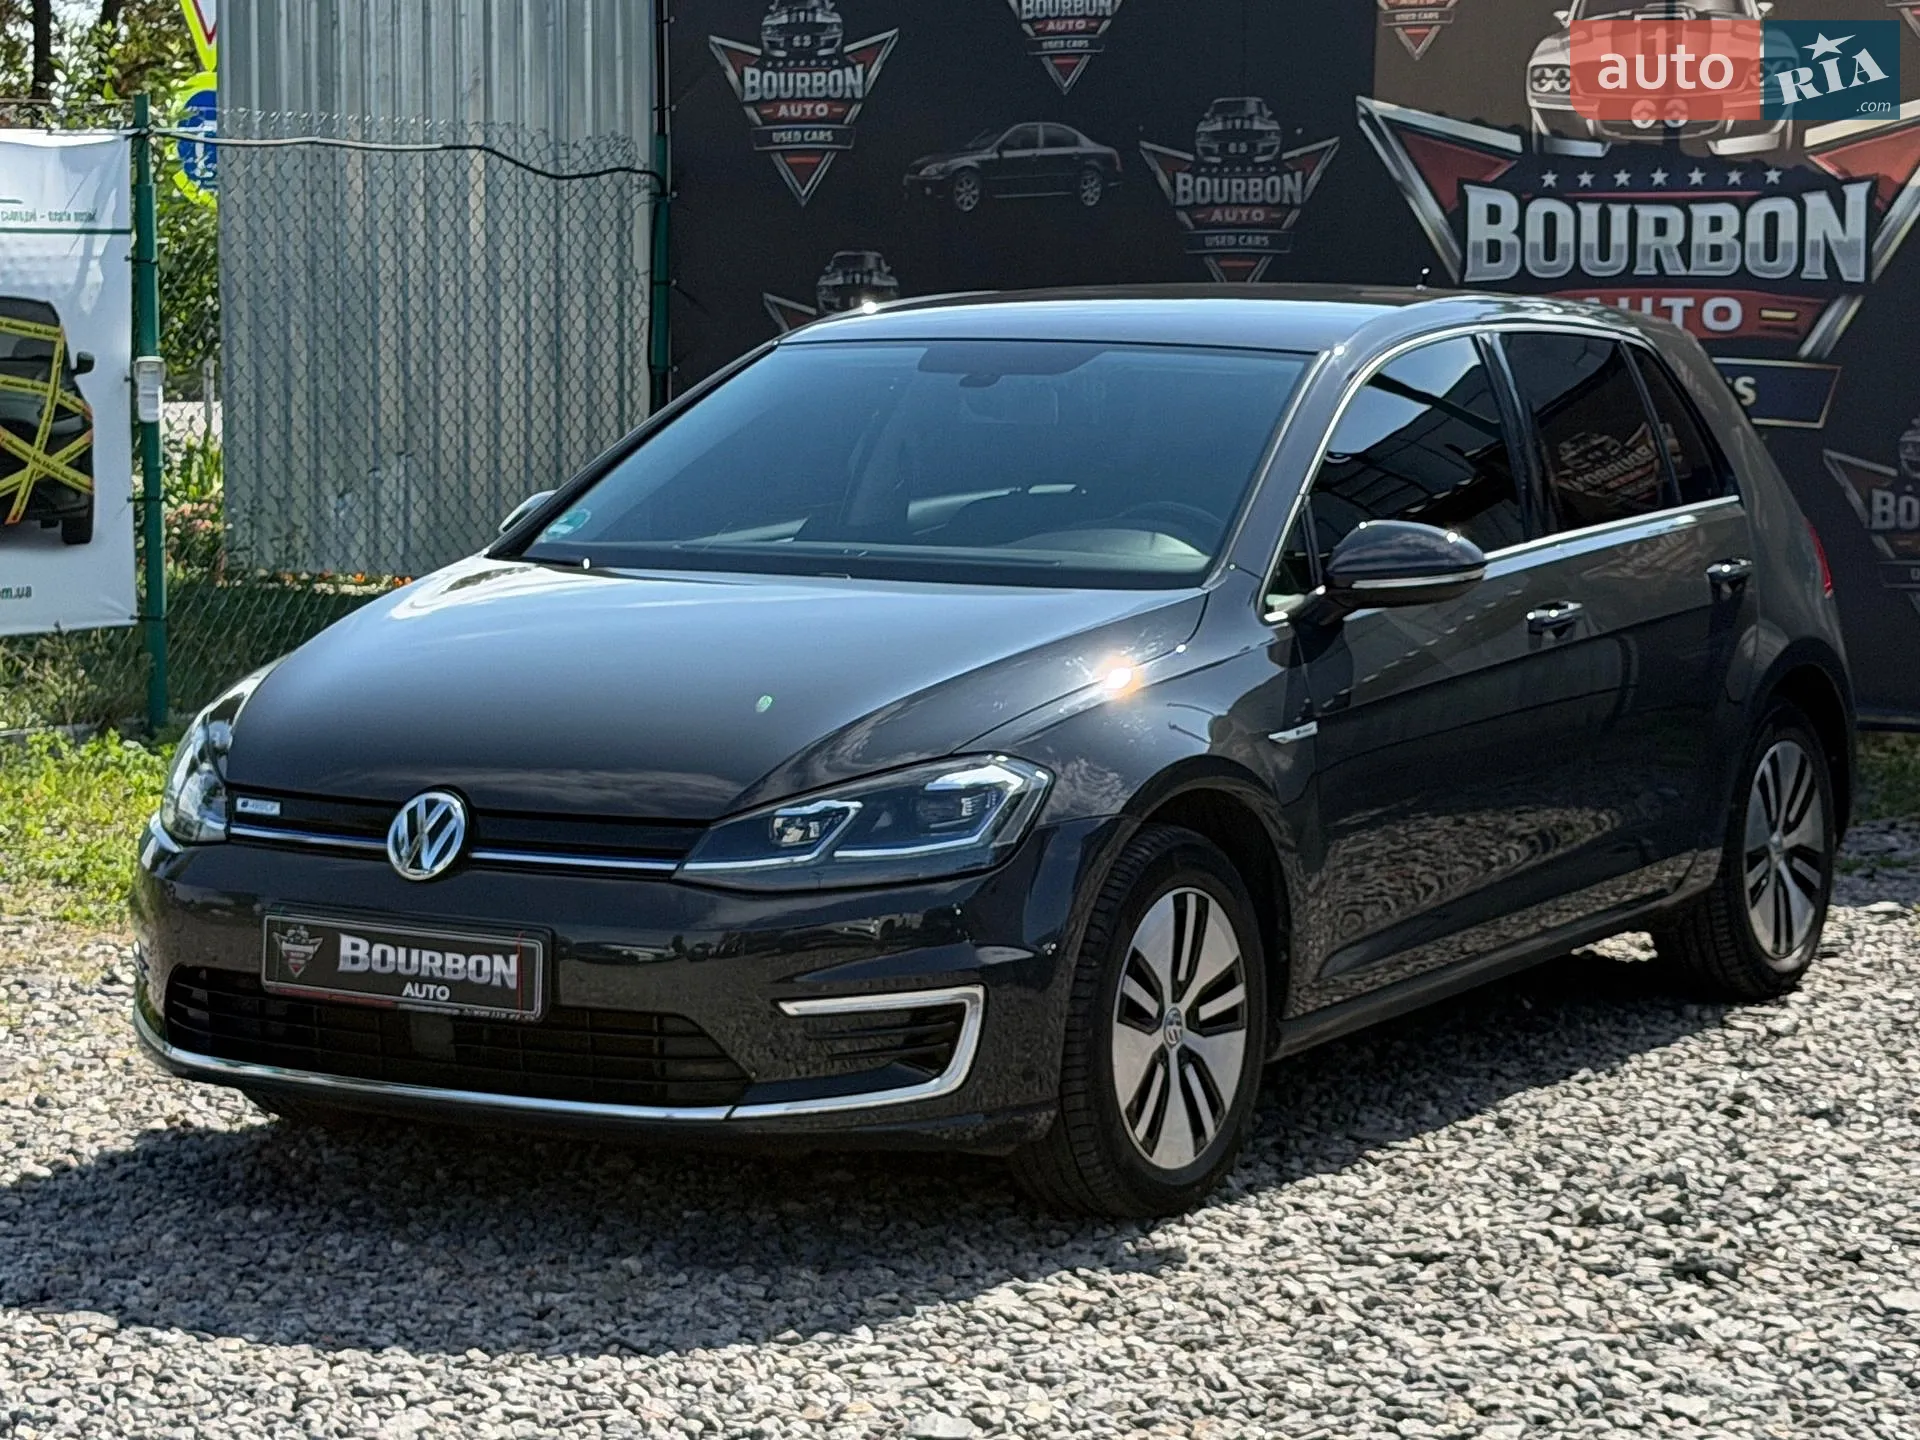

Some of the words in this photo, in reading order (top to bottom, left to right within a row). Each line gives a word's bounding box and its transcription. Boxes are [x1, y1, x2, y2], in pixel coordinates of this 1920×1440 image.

[1021, 0, 1112, 20] BOURBON
[1046, 20, 1086, 31] AUTO
[743, 63, 864, 102] BOURBON
[778, 103, 829, 117] AUTO
[1175, 171, 1303, 206] BOURBON
[1211, 209, 1266, 222] AUTO
[1463, 181, 1871, 284] BOURBON
[337, 933, 520, 990] BOURBON
[402, 981, 450, 1001] AUTO
